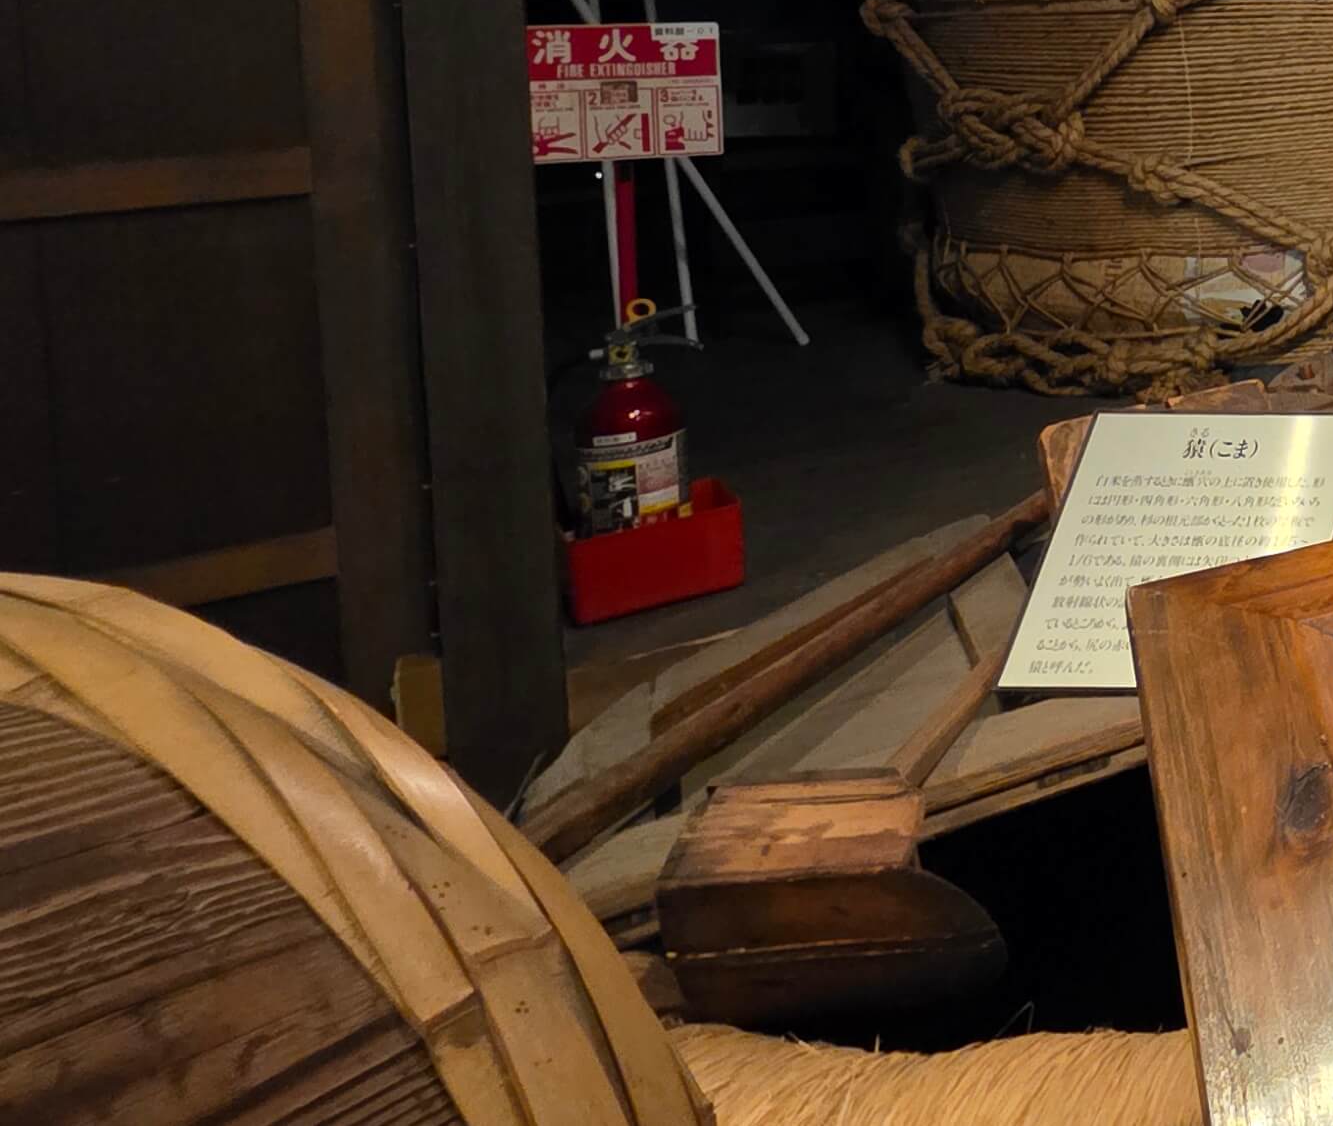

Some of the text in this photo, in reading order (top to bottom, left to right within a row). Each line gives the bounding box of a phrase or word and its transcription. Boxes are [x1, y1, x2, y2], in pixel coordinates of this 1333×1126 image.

[531, 28, 700, 66] 消火器
[556, 61, 677, 78] FIRE EXTINGUISHER
